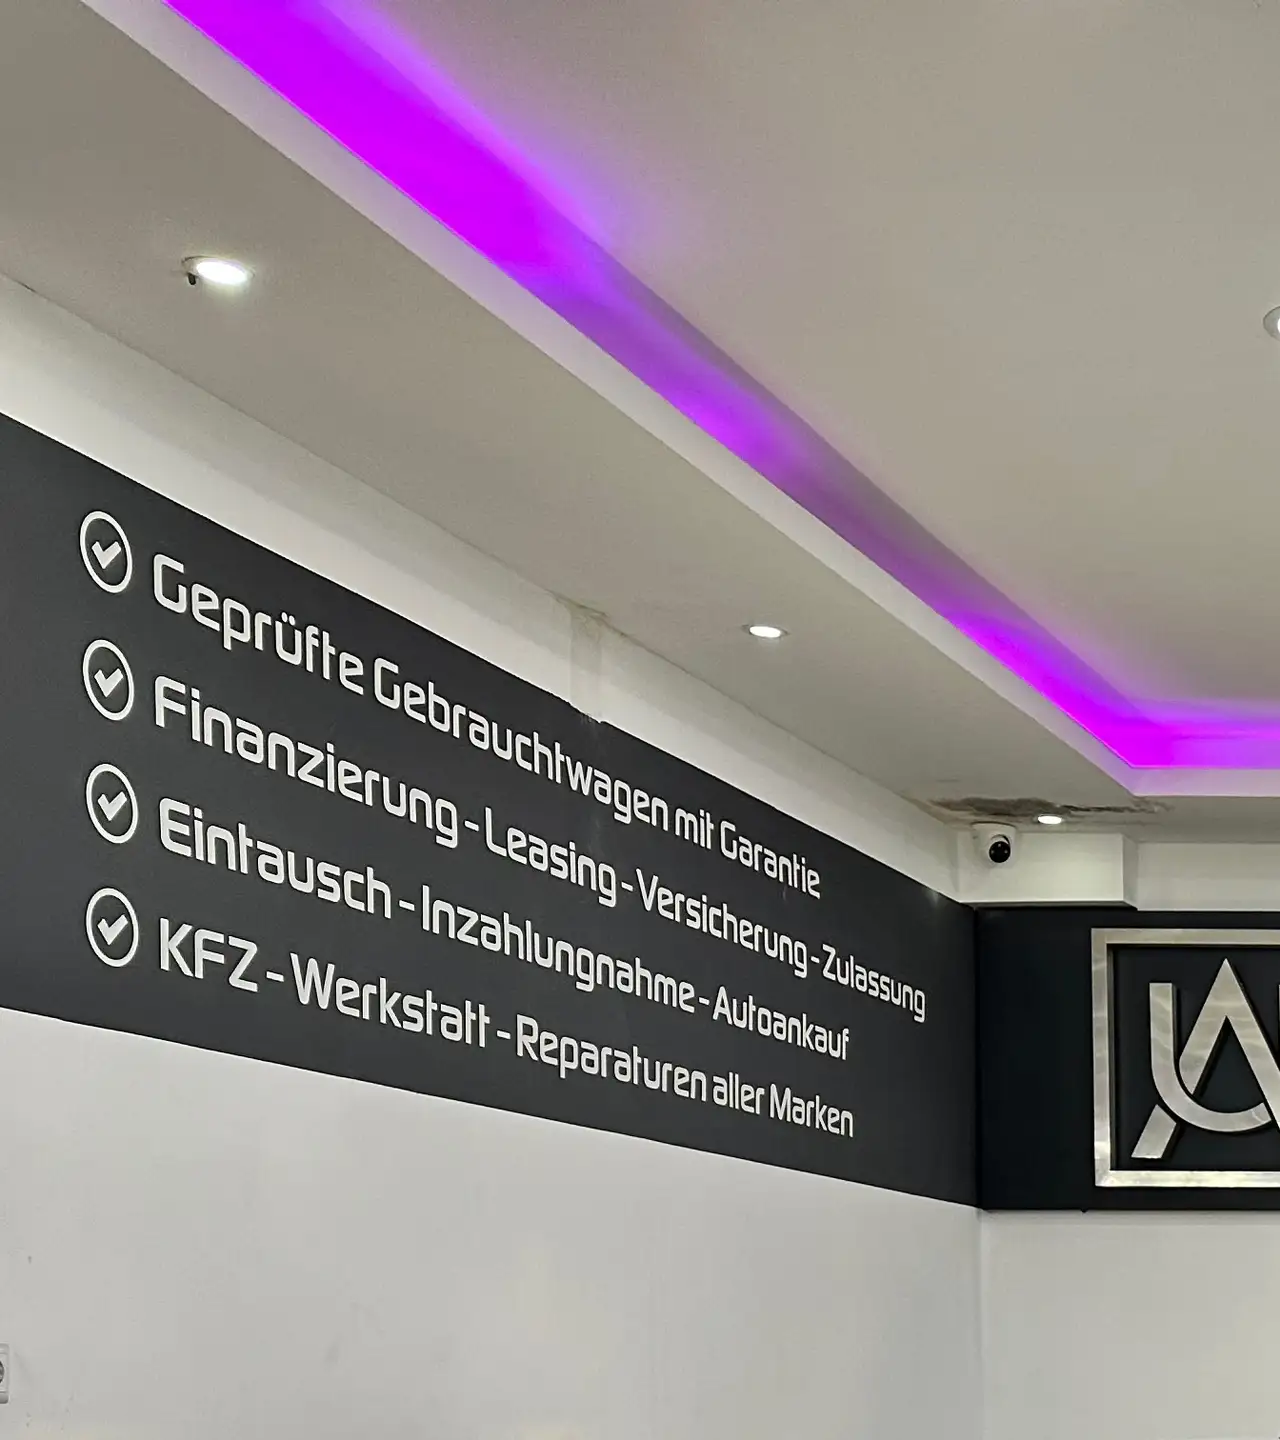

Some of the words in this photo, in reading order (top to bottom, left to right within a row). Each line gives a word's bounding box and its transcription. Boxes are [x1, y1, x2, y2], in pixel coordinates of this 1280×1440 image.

[153, 553, 364, 692] Geprüfte
[373, 657, 669, 829] Gebrauchtwagen
[675, 808, 714, 849] mit
[720, 819, 822, 899] Garantie
[154, 675, 458, 849] Finanzierung
[486, 807, 617, 909] Leasing
[636, 868, 808, 979] Versicherung
[821, 943, 927, 1023] Zulassung
[159, 797, 392, 919] Eintausch
[422, 884, 695, 1013] Inzahlungnahme
[713, 986, 850, 1061] Autoankauf
[159, 917, 259, 993] KFZ
[290, 952, 490, 1048] Werkstatt
[516, 1015, 707, 1103] Reparaturen
[713, 1072, 765, 1116] aller
[770, 1083, 854, 1138] Marken
